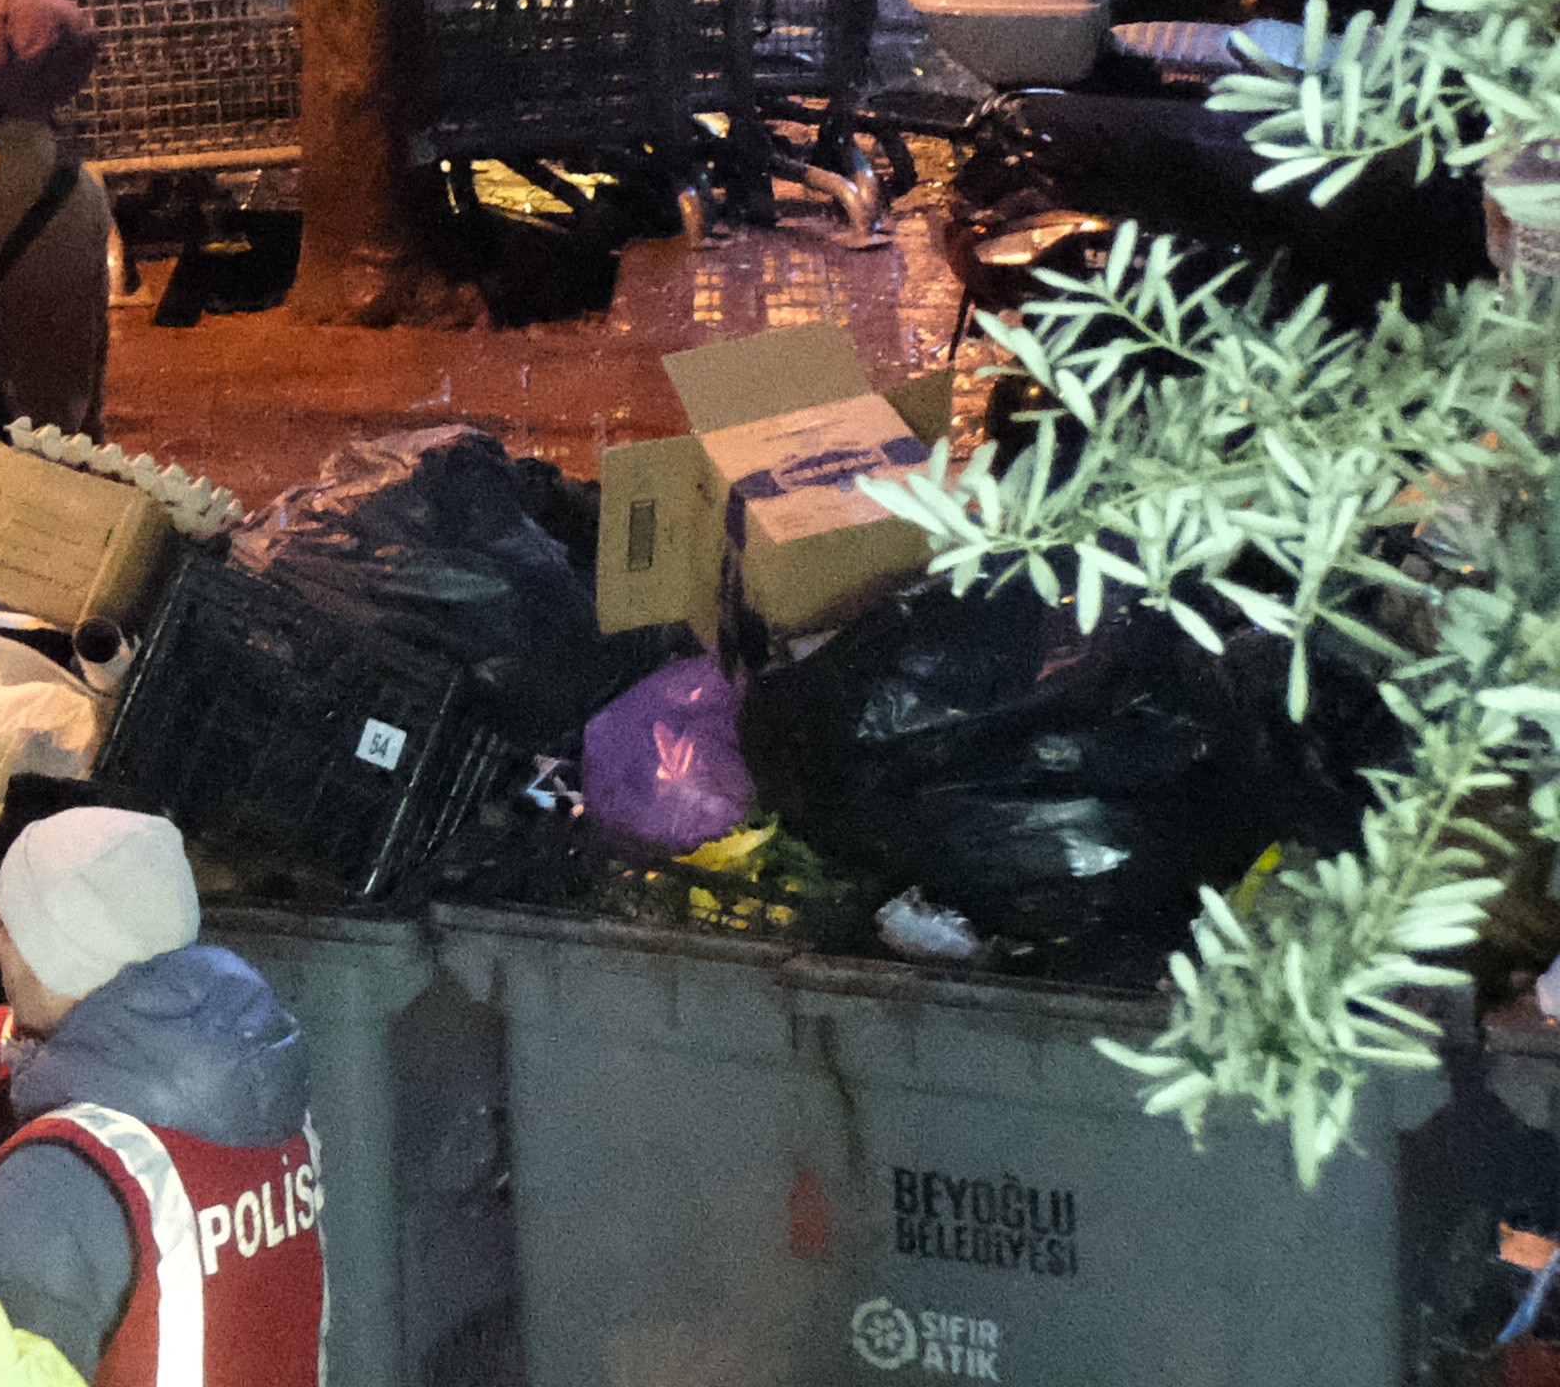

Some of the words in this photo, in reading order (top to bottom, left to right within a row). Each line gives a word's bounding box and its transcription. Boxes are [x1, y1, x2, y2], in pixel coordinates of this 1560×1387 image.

[368, 732, 396, 759] 54
[197, 1153, 316, 1276] POLİS
[893, 1166, 1076, 1239] BEYOĞLU
[918, 1310, 999, 1349] SIFIR
[923, 1340, 1004, 1384] ATIK
